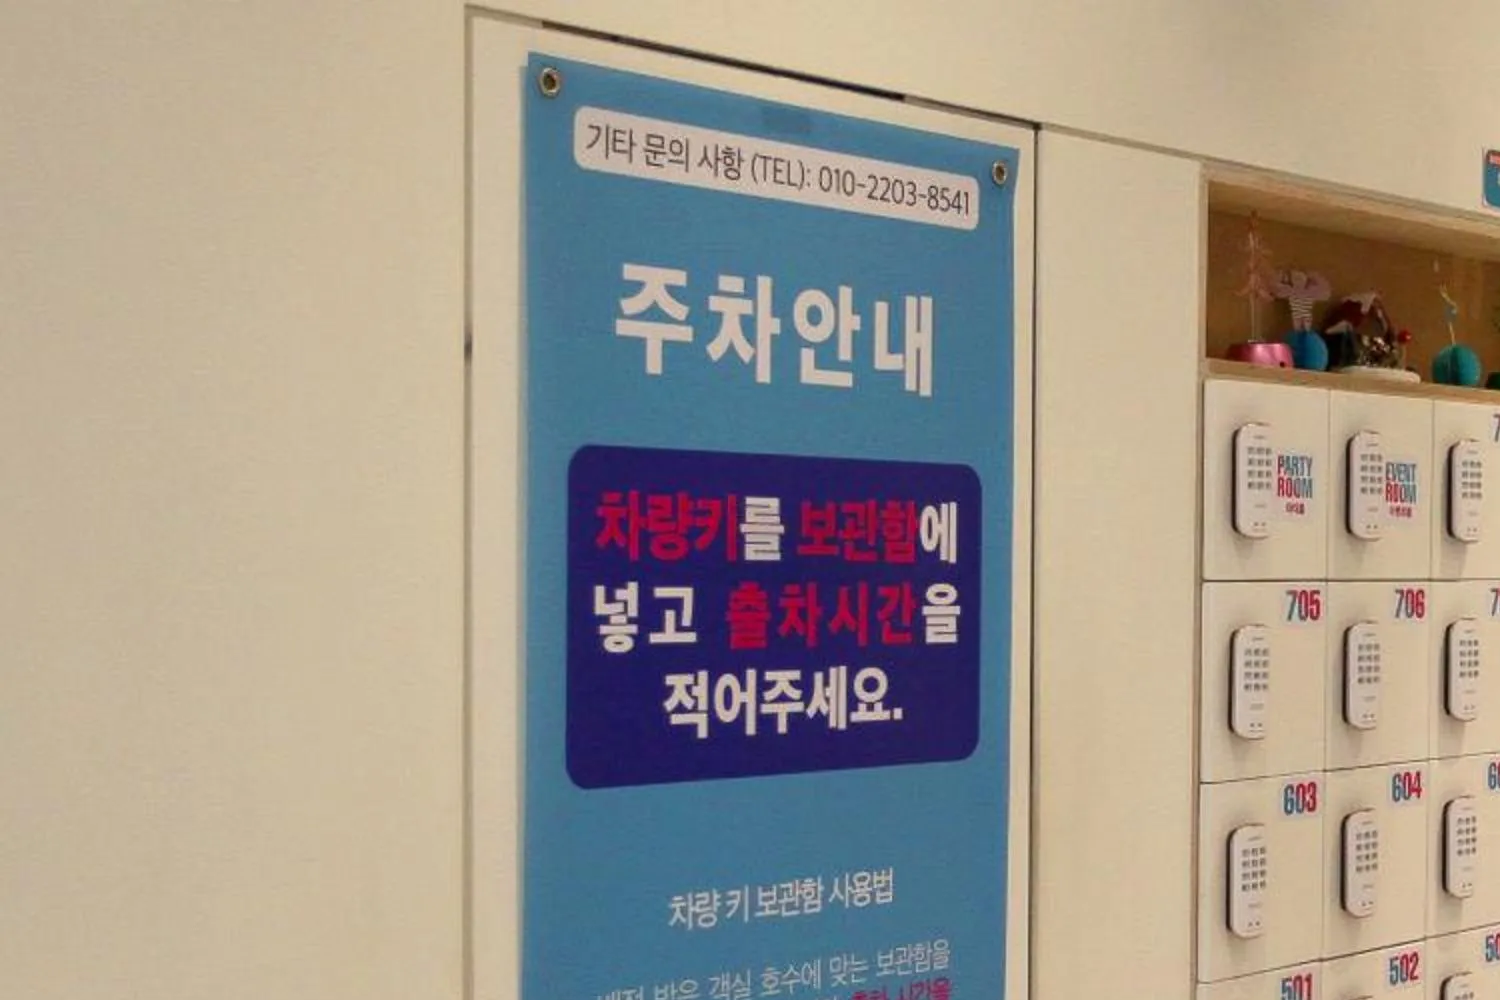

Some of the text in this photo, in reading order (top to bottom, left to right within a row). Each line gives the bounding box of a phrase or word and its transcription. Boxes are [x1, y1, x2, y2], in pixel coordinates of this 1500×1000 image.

[587, 123, 970, 216] 기타 문의 사항 (TEL): 010-2203-8541
[615, 263, 933, 397] 주차안내
[1277, 455, 1313, 477] PARTY
[1386, 462, 1416, 482] EVENT
[1277, 477, 1313, 499] ROOM
[1386, 482, 1417, 504] ROOM
[595, 489, 957, 564] 차량키를 보관함에
[593, 581, 961, 654] 넣고 출차시간을
[1286, 590, 1321, 621] 705
[1395, 588, 1425, 619] 706
[663, 666, 903, 739] 적어주세요.
[1284, 782, 1317, 816] 603
[1391, 771, 1422, 802] 604
[668, 867, 894, 930] 차량 키 보관함 사용법
[758, 957, 822, 996] 호수에
[829, 953, 869, 988] 맞는
[876, 939, 949, 977] 보관함을
[1389, 952, 1420, 985] 502
